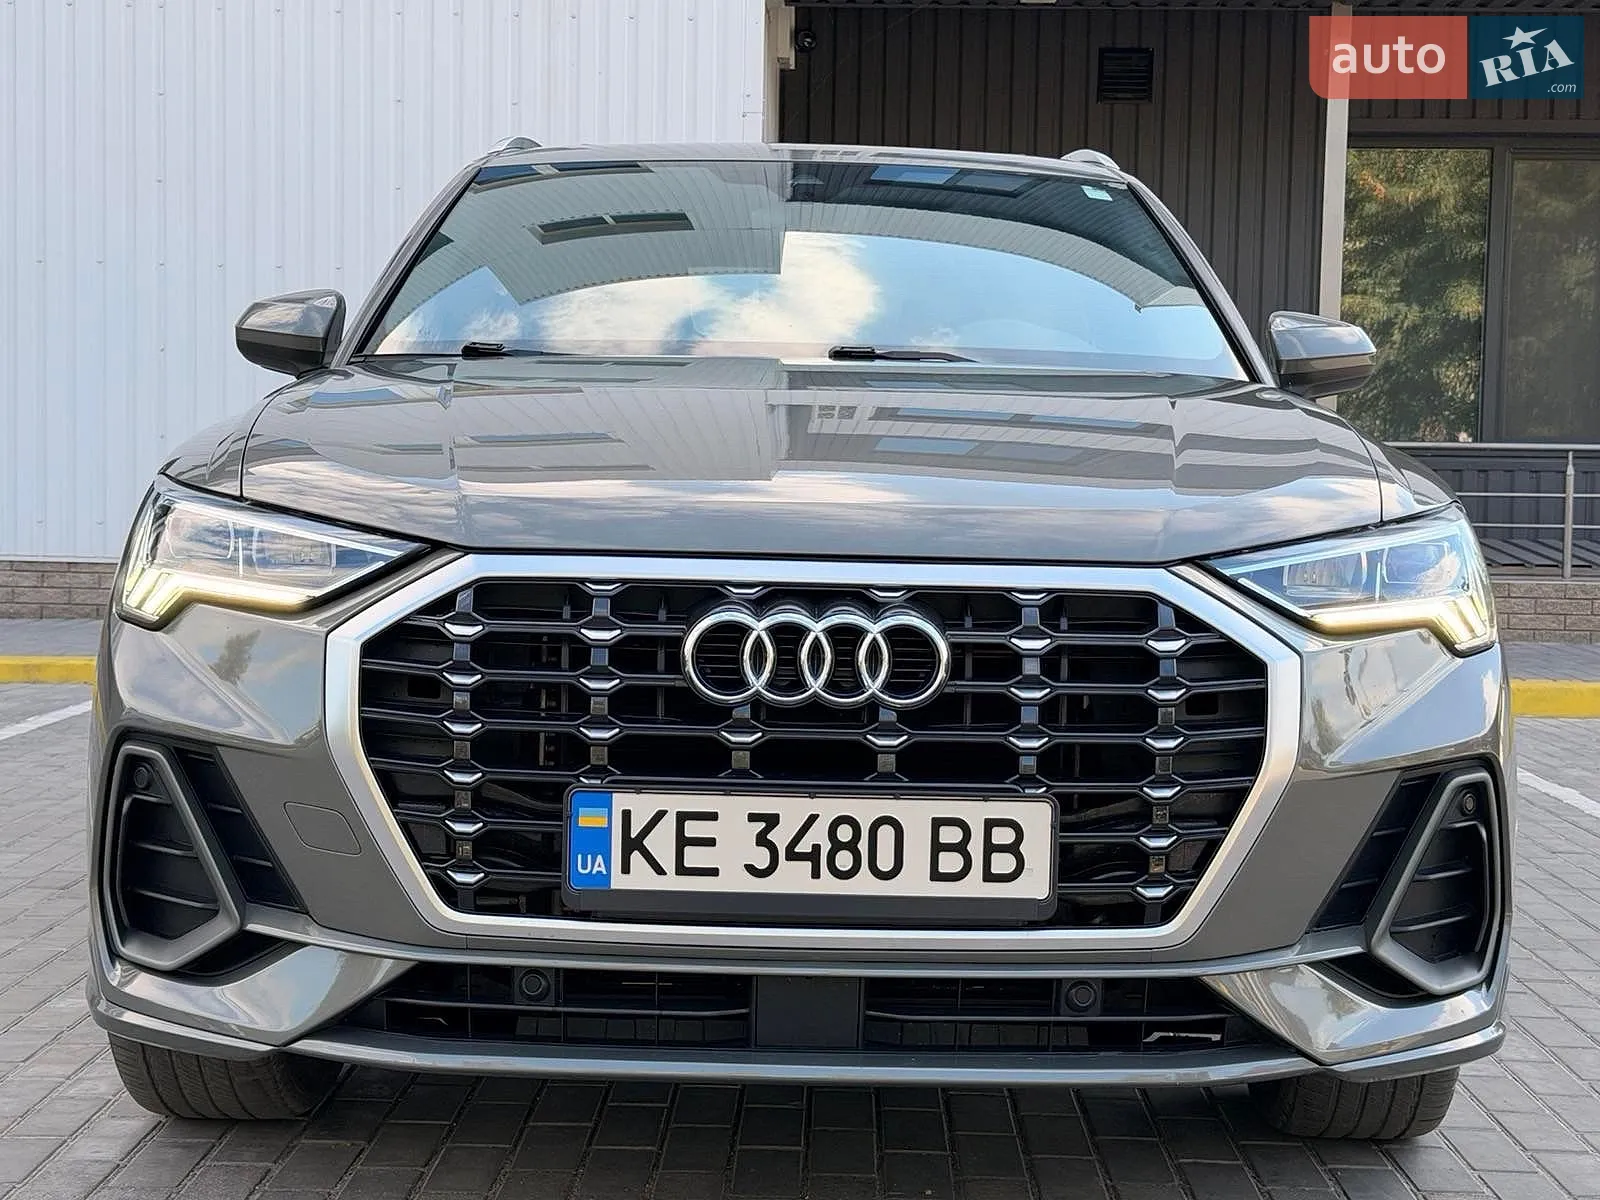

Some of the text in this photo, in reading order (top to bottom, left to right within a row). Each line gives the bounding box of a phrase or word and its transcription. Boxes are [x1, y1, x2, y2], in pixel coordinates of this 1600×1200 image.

[576, 854, 608, 875] UA
[620, 808, 1026, 883] KE 3480 BB
